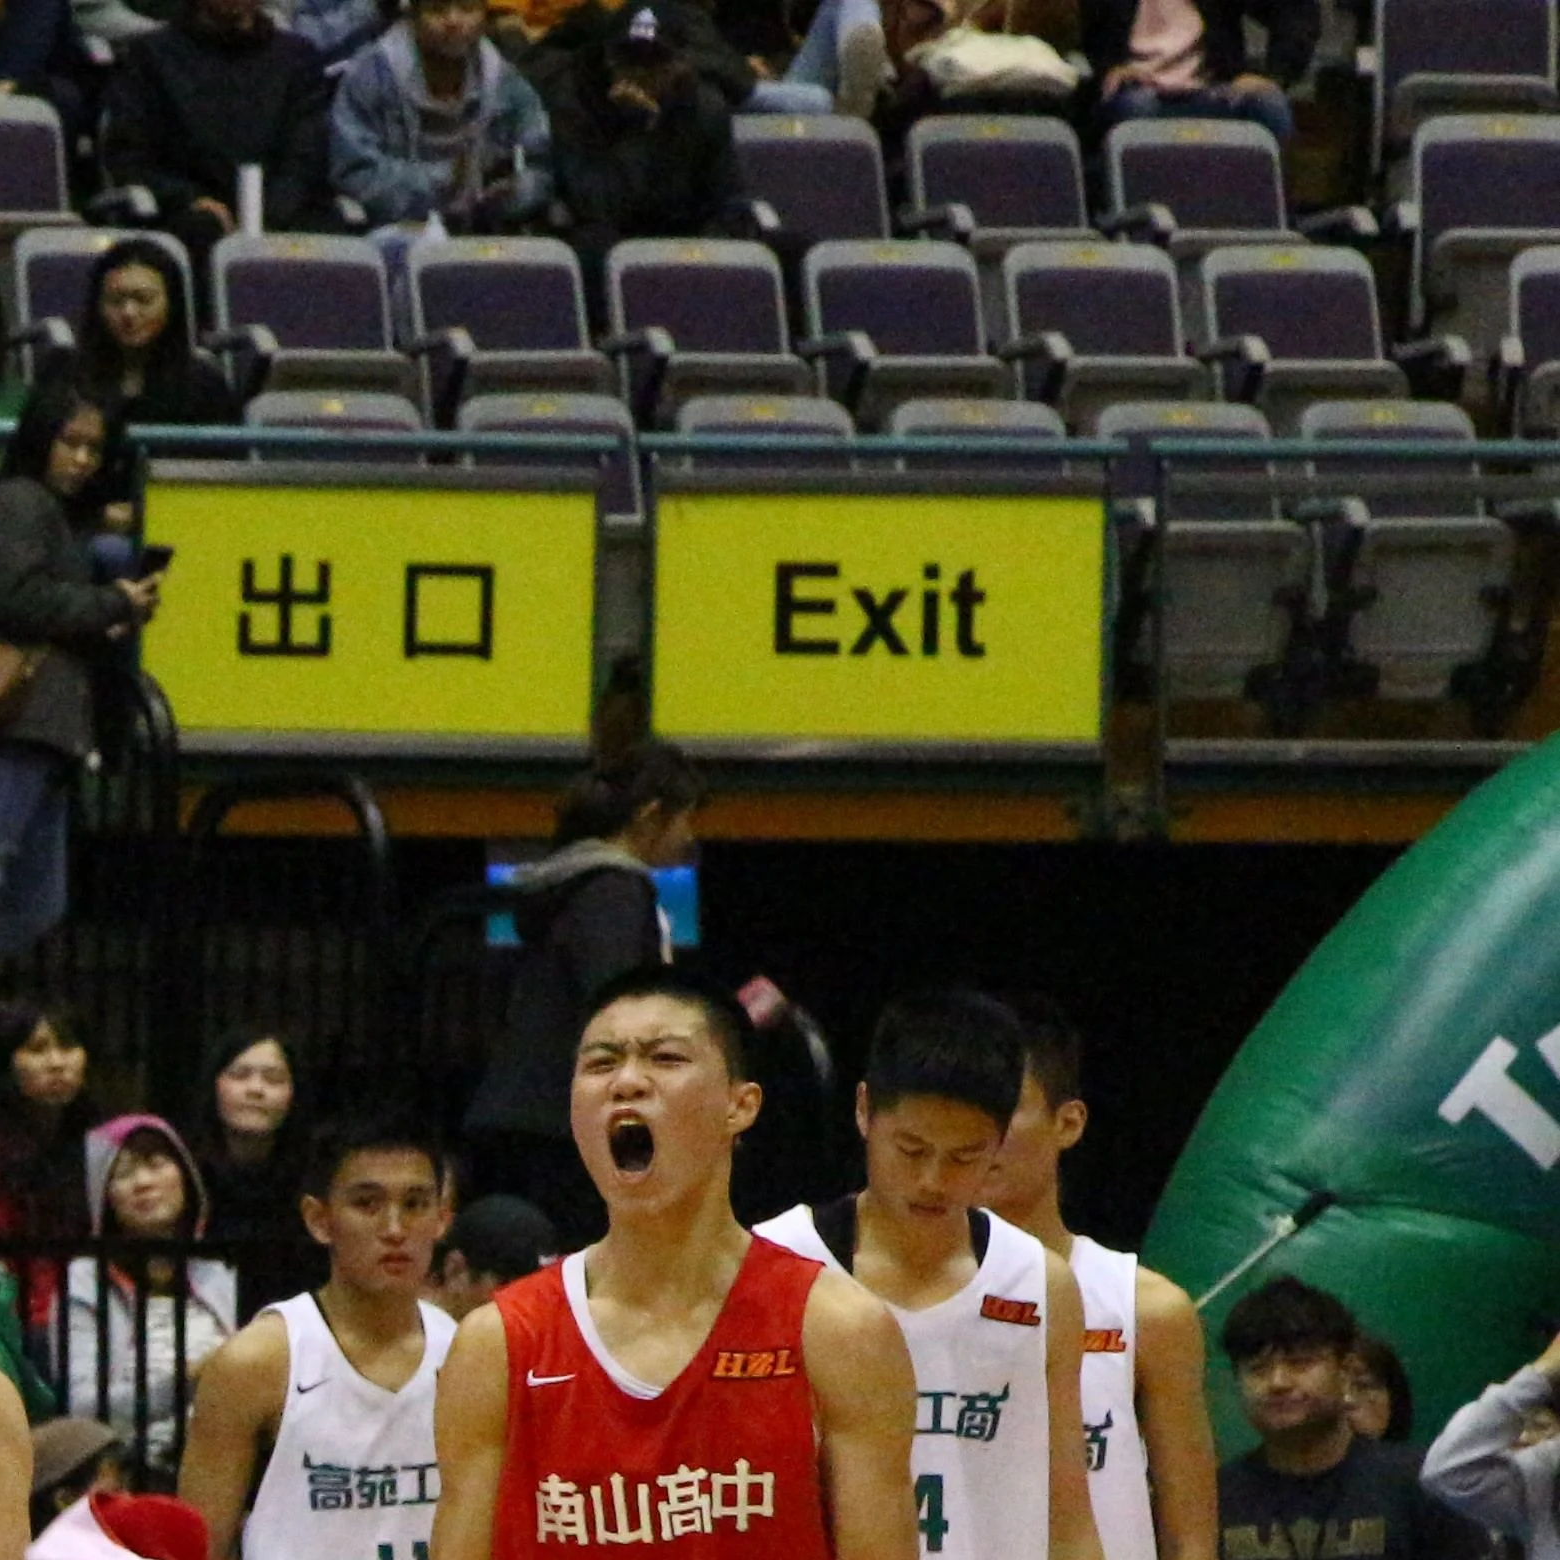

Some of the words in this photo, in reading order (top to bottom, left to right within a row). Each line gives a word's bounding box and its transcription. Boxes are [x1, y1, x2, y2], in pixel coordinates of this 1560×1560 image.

[239, 554, 494, 660] 出口
[775, 561, 986, 656] Exit
[535, 1458, 776, 1546] 南山高中
